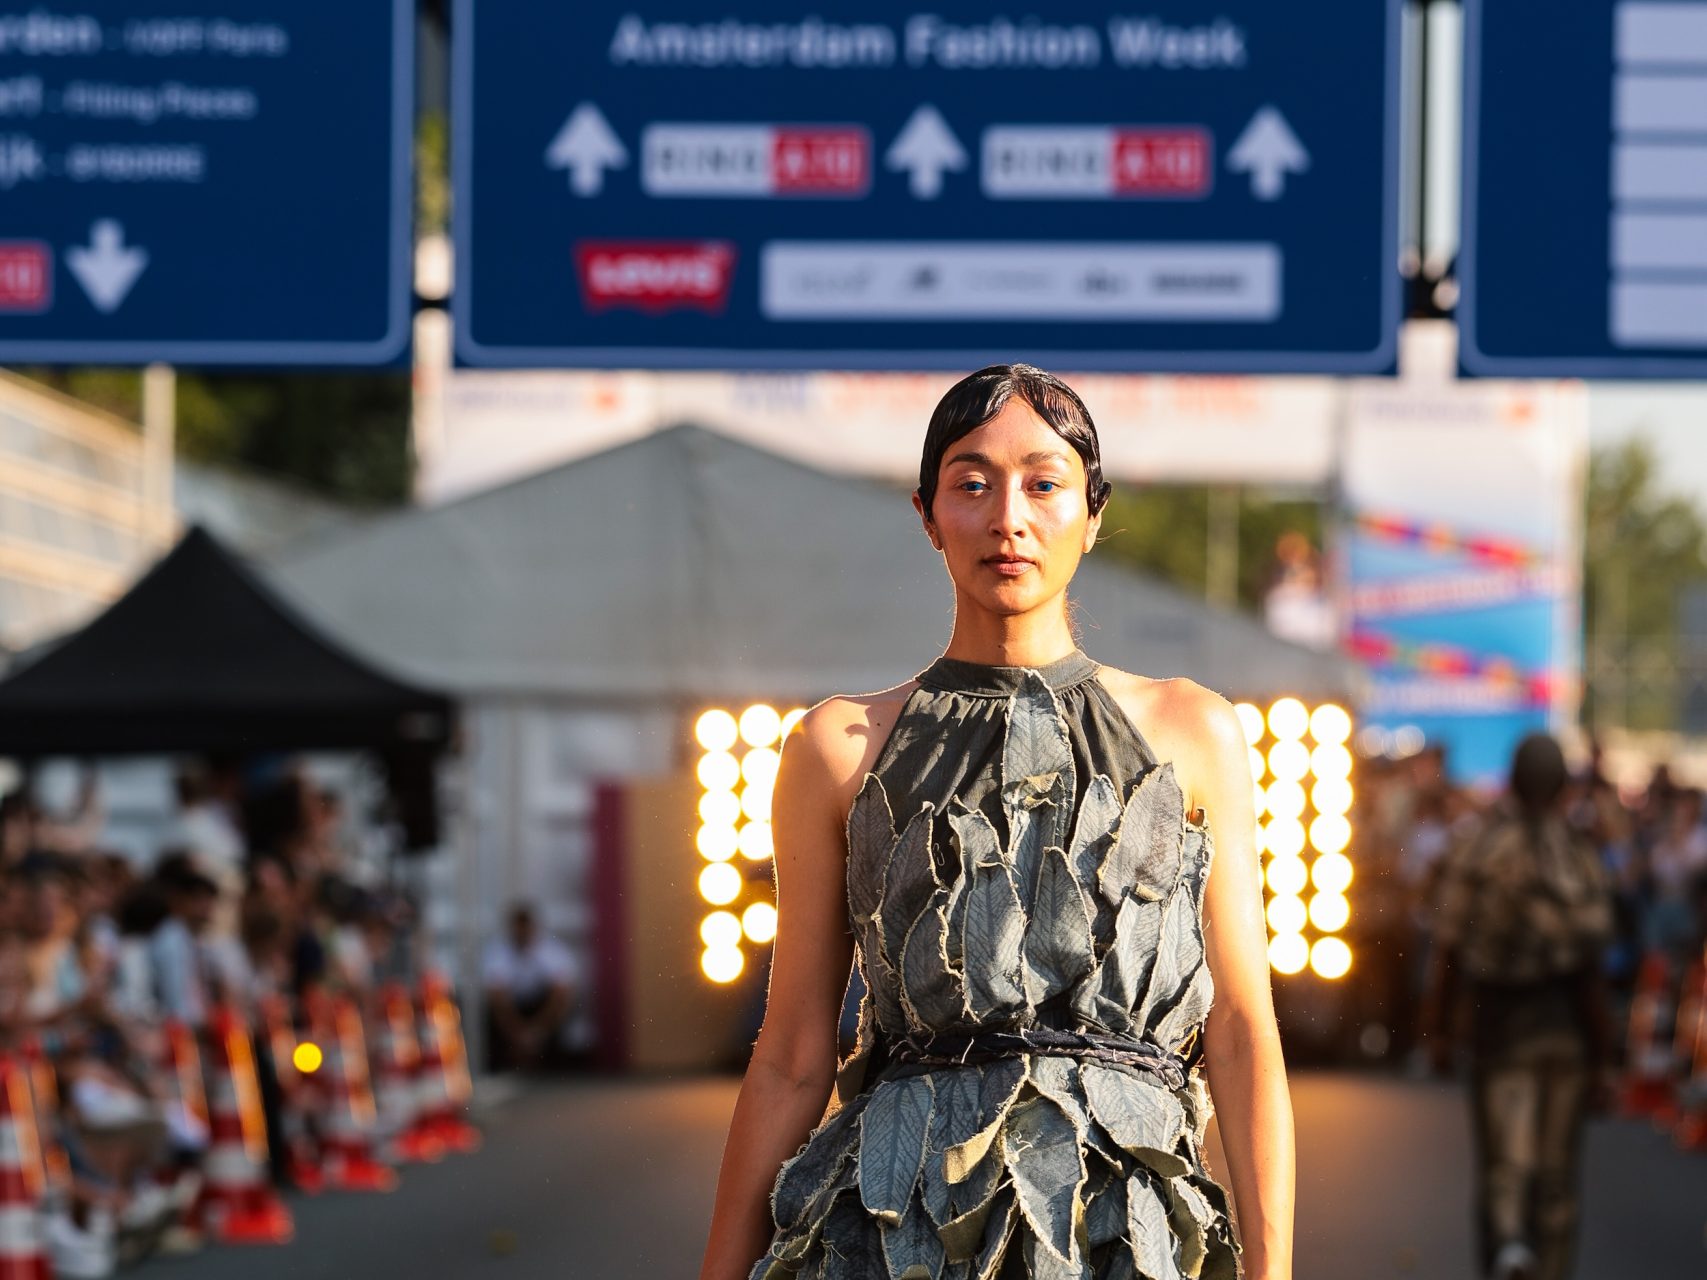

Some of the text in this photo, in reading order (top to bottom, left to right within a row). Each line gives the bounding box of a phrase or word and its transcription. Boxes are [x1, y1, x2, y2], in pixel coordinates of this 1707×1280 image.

[612, 15, 1245, 67] Amsterdam Fashion Week
